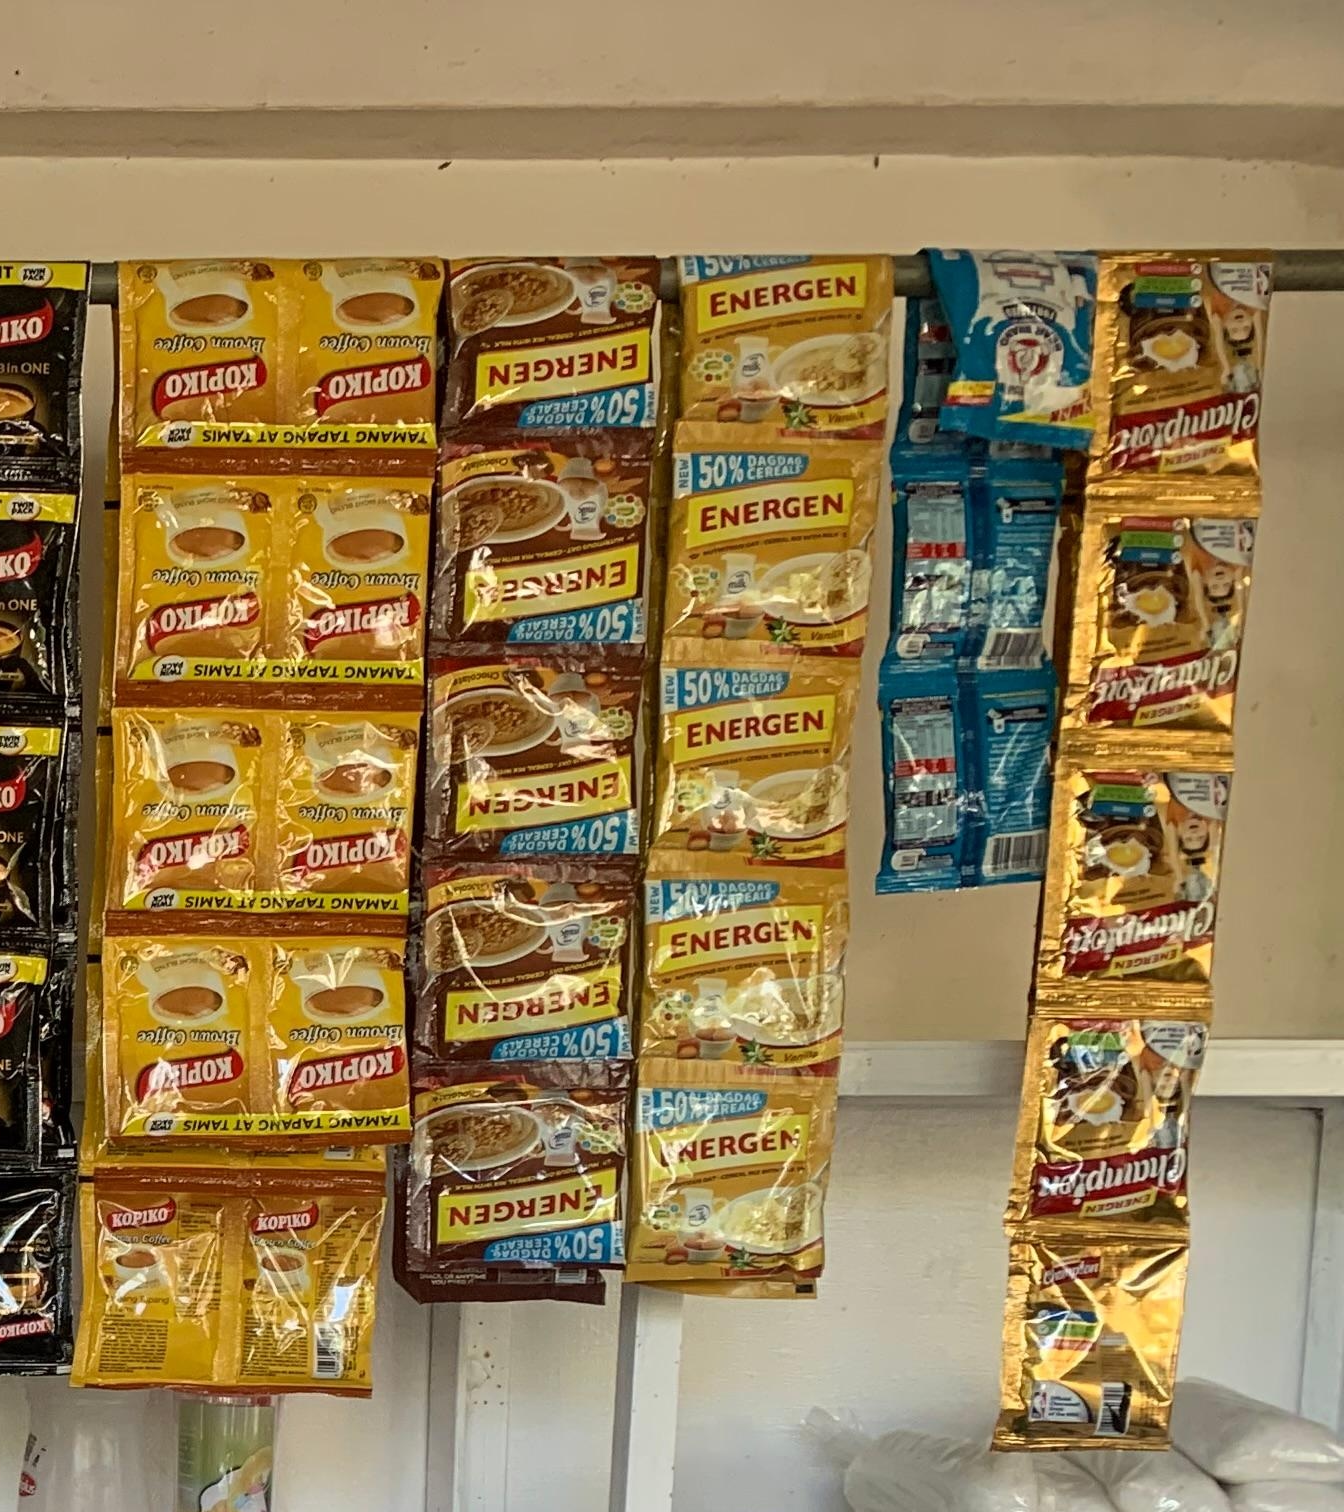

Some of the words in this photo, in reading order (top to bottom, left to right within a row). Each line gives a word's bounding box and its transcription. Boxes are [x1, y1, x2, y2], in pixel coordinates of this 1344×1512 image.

[22, 266, 47, 275] TWIN
[22, 273, 47, 283] PACK
[709, 275, 857, 318] ENERGEN
[153, 337, 206, 352] Coffee
[209, 337, 266, 353] Brown
[319, 335, 372, 351] Coffee
[374, 335, 431, 352] Brown
[488, 342, 639, 387] ENERGEN
[163, 363, 258, 399] KOPIKO
[328, 363, 423, 399] KOPIKO
[589, 388, 639, 425] 50%
[526, 411, 584, 424] DAGDAG
[202, 430, 250, 443] TAMIS
[254, 430, 277, 444] AT
[283, 430, 350, 444] TAPANG
[355, 430, 428, 444] TAMANG
[747, 455, 803, 468] DAGDAG
[678, 458, 689, 489] NEW
[698, 455, 744, 488] 50%
[700, 492, 845, 533] ENERGEN
[457, 981, 611, 1025] ENERGEN
